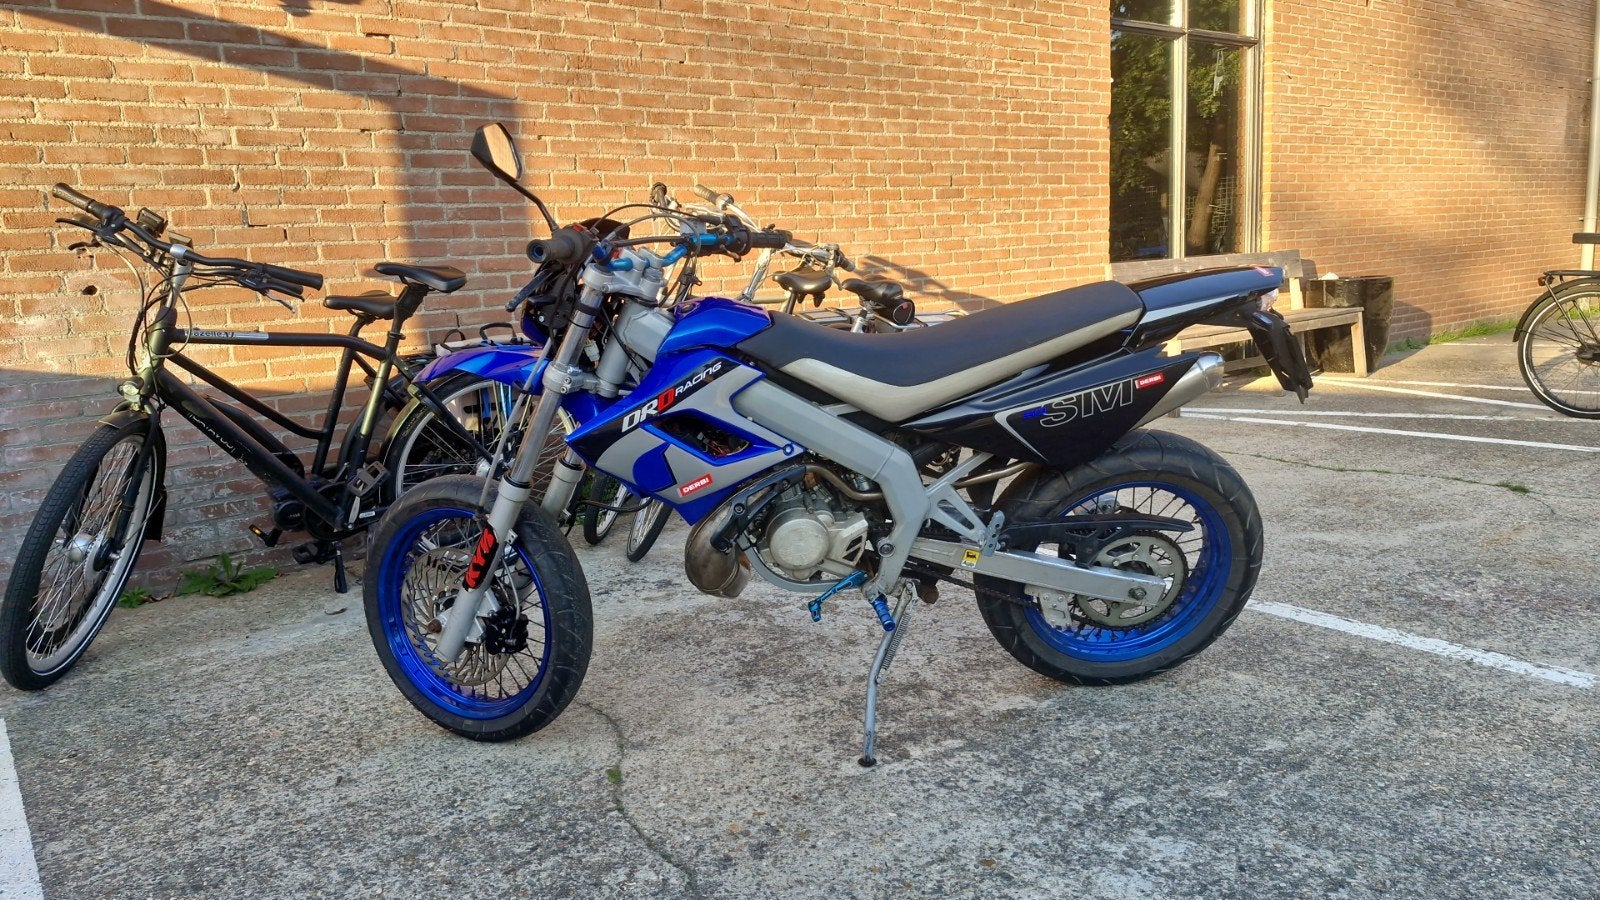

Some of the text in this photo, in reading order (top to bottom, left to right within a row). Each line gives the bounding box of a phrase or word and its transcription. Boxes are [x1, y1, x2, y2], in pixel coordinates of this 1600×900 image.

[1139, 374, 1162, 386] DERBI
[622, 387, 676, 433] DRD
[1040, 377, 1133, 427] SM
[682, 477, 710, 493] DERBI
